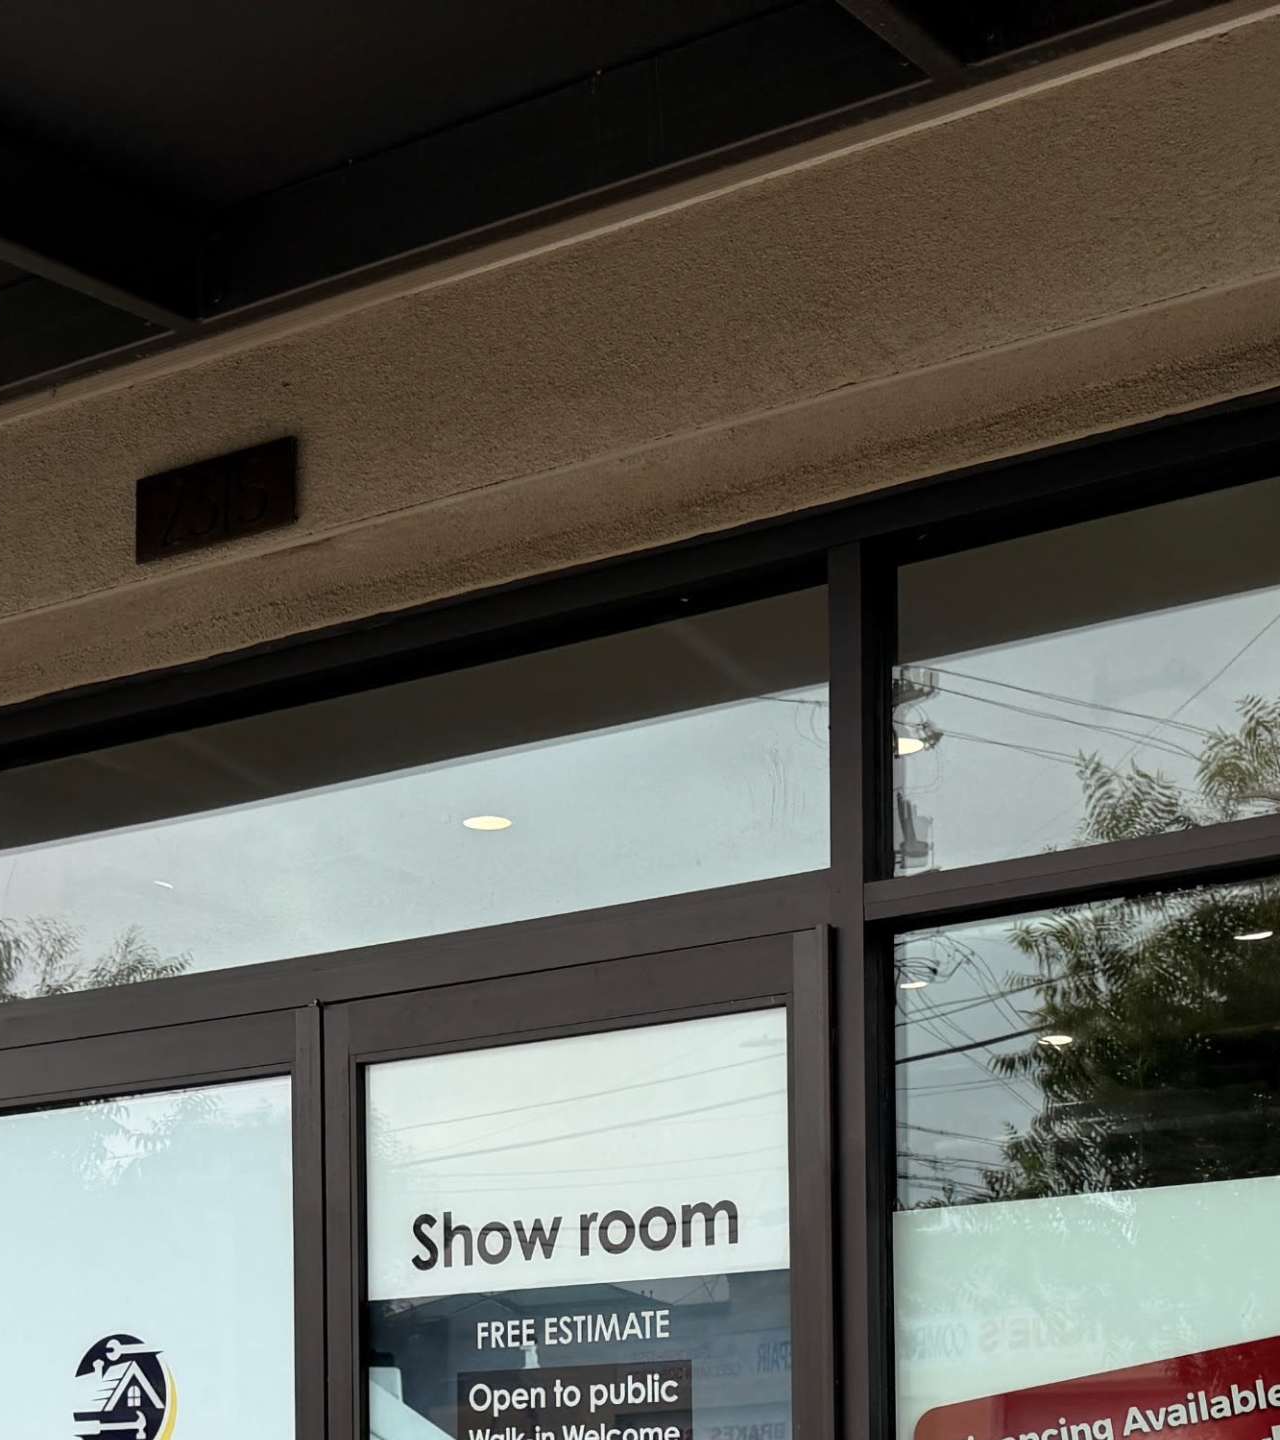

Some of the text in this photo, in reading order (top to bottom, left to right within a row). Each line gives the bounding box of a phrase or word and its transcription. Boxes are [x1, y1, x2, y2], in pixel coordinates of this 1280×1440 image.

[412, 1200, 738, 1270] Show room
[478, 1310, 669, 1349] FREE ESTIMATE
[469, 1374, 678, 1417] Open to public
